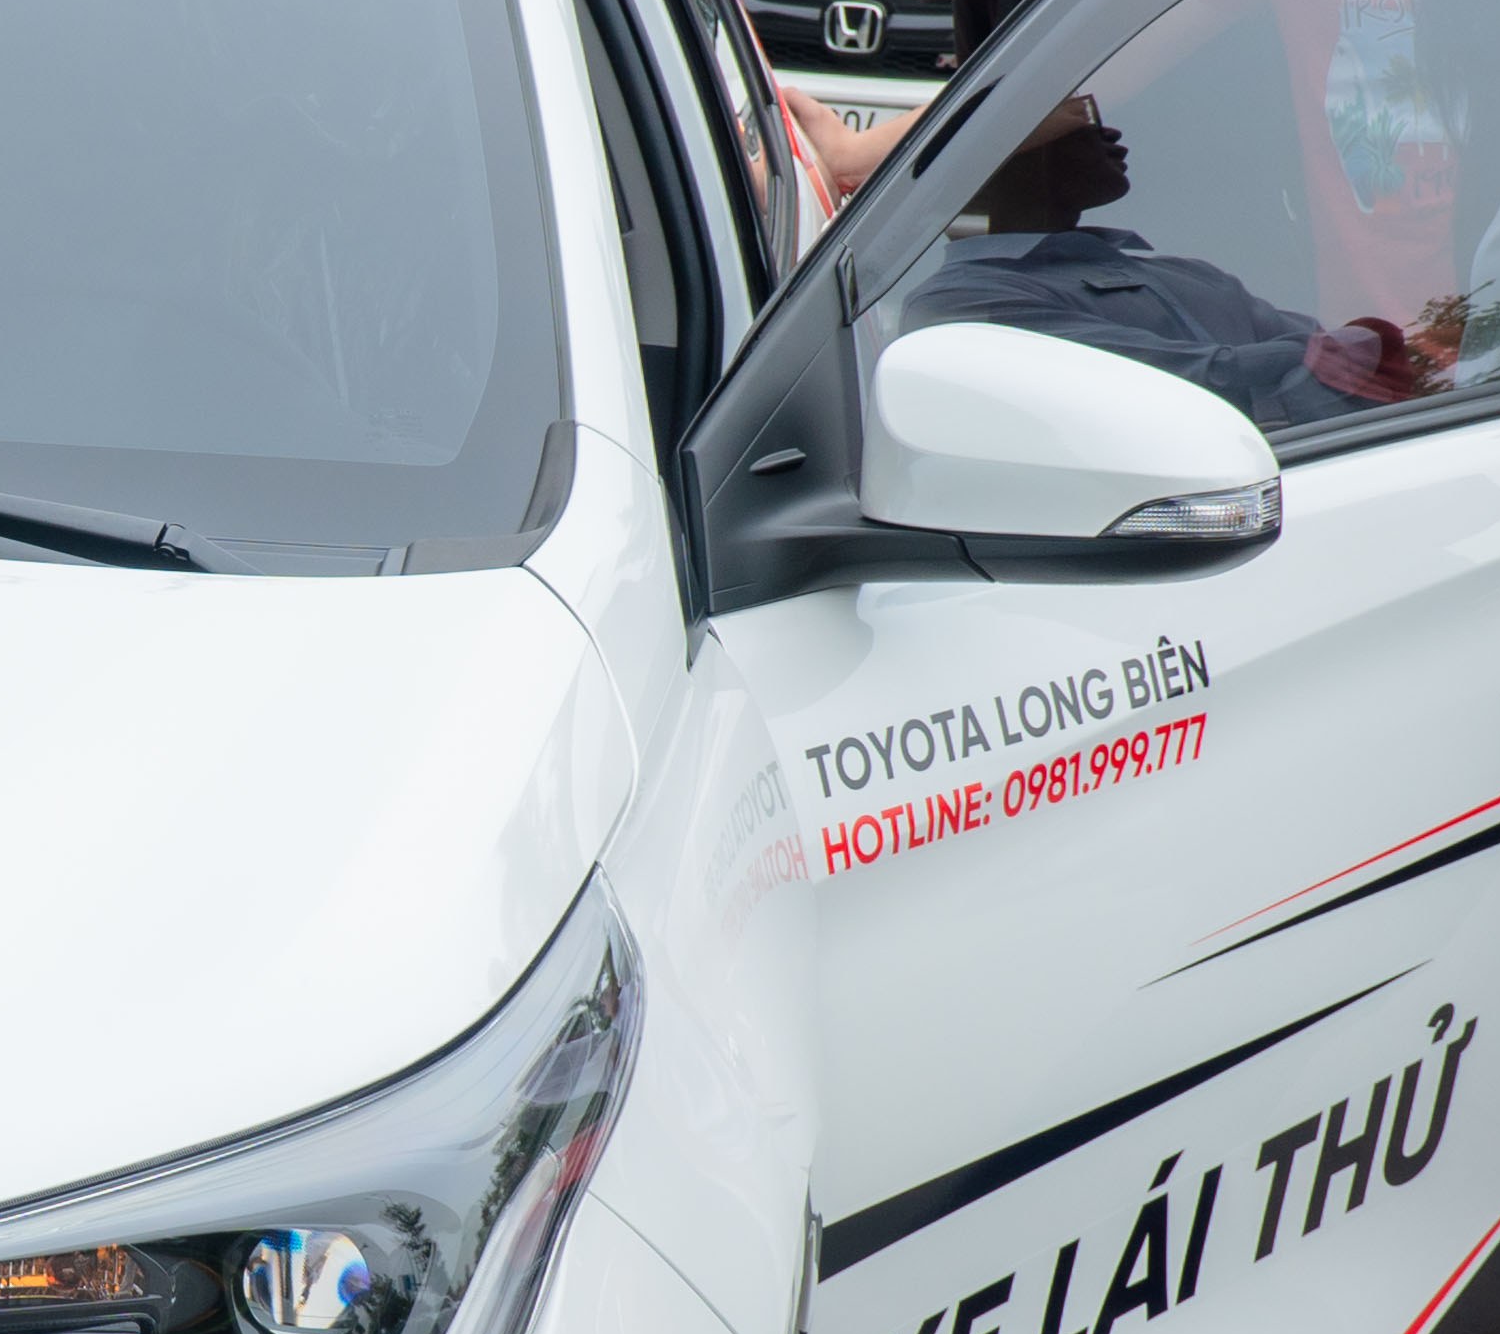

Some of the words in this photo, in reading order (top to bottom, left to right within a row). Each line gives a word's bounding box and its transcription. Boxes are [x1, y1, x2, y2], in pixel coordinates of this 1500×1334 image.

[806, 704, 991, 798] TOYOTA
[994, 668, 1115, 747] LONG
[1121, 635, 1211, 709] BIÊN
[821, 782, 993, 875] HOTLINE:
[1002, 713, 1207, 818] 0981.999.777
[1253, 1002, 1479, 1263] THỬ
